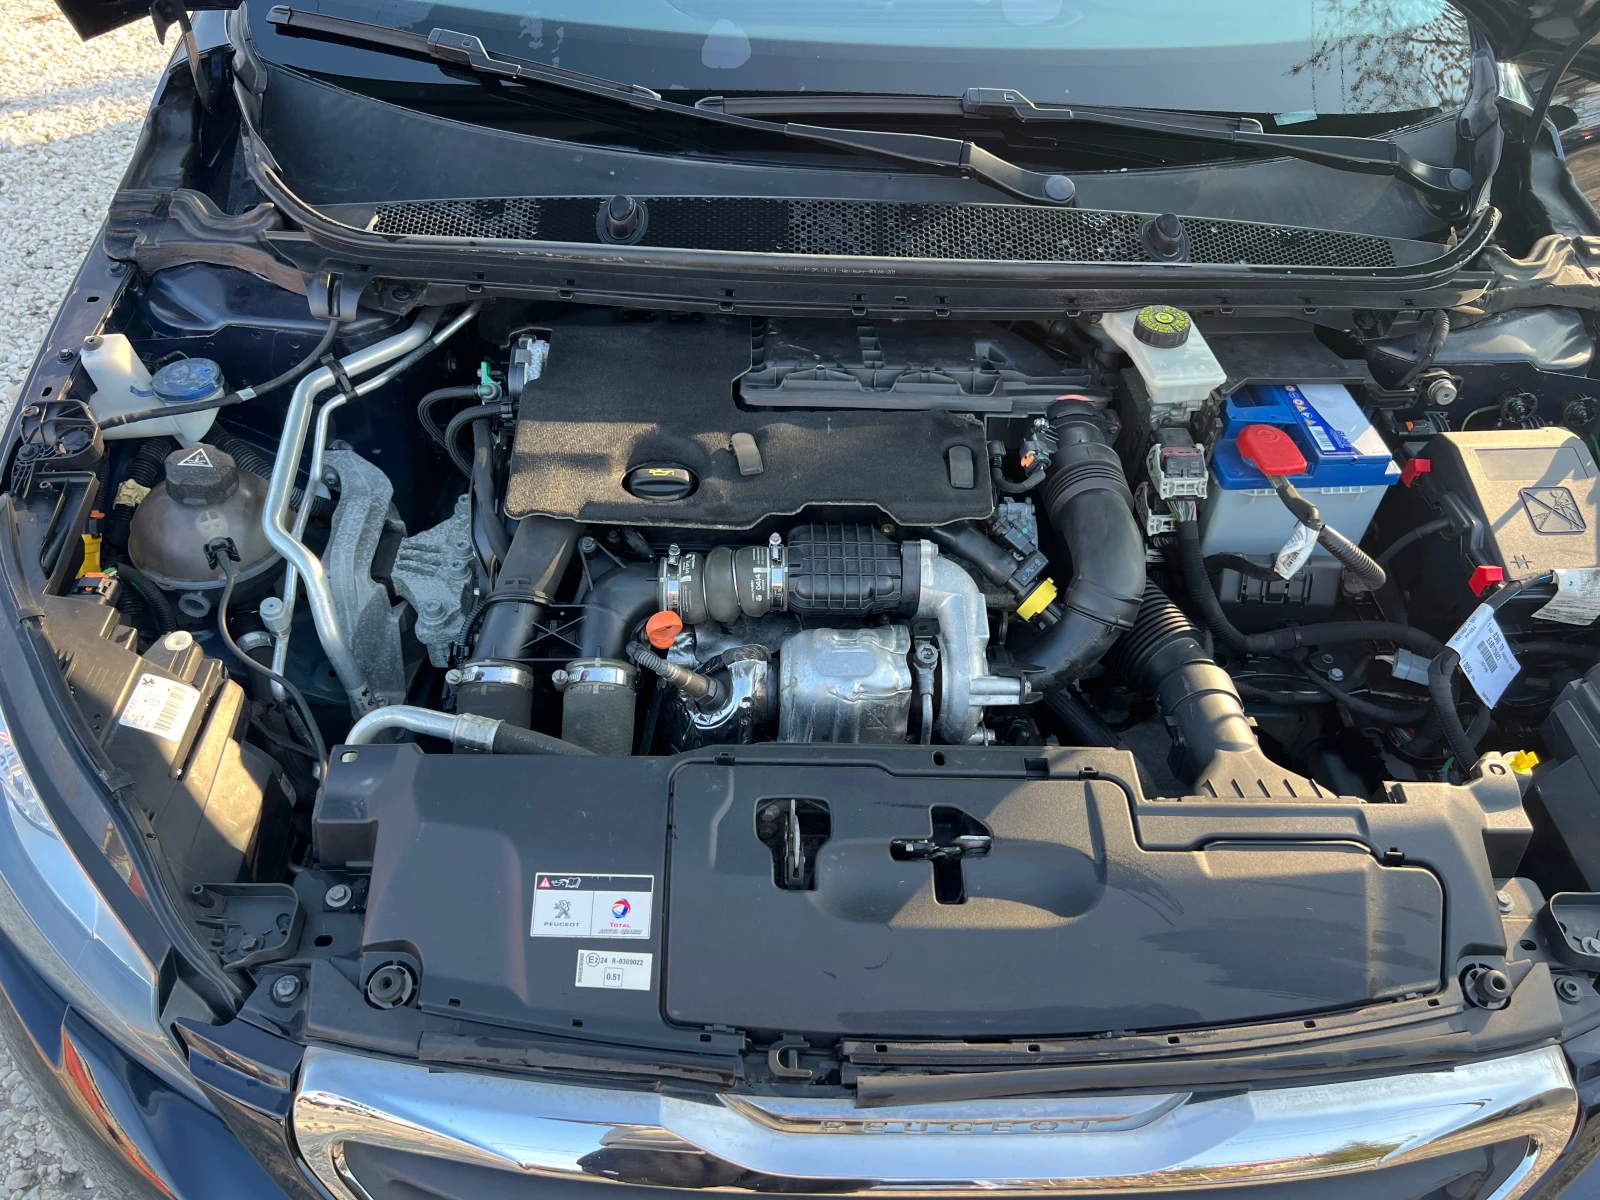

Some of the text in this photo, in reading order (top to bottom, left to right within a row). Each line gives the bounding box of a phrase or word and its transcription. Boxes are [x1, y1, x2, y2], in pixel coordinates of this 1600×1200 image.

[611, 957, 644, 966] R-0309022
[606, 973, 621, 981] 0.51
[819, 1119, 1098, 1133] PEUGEOT
